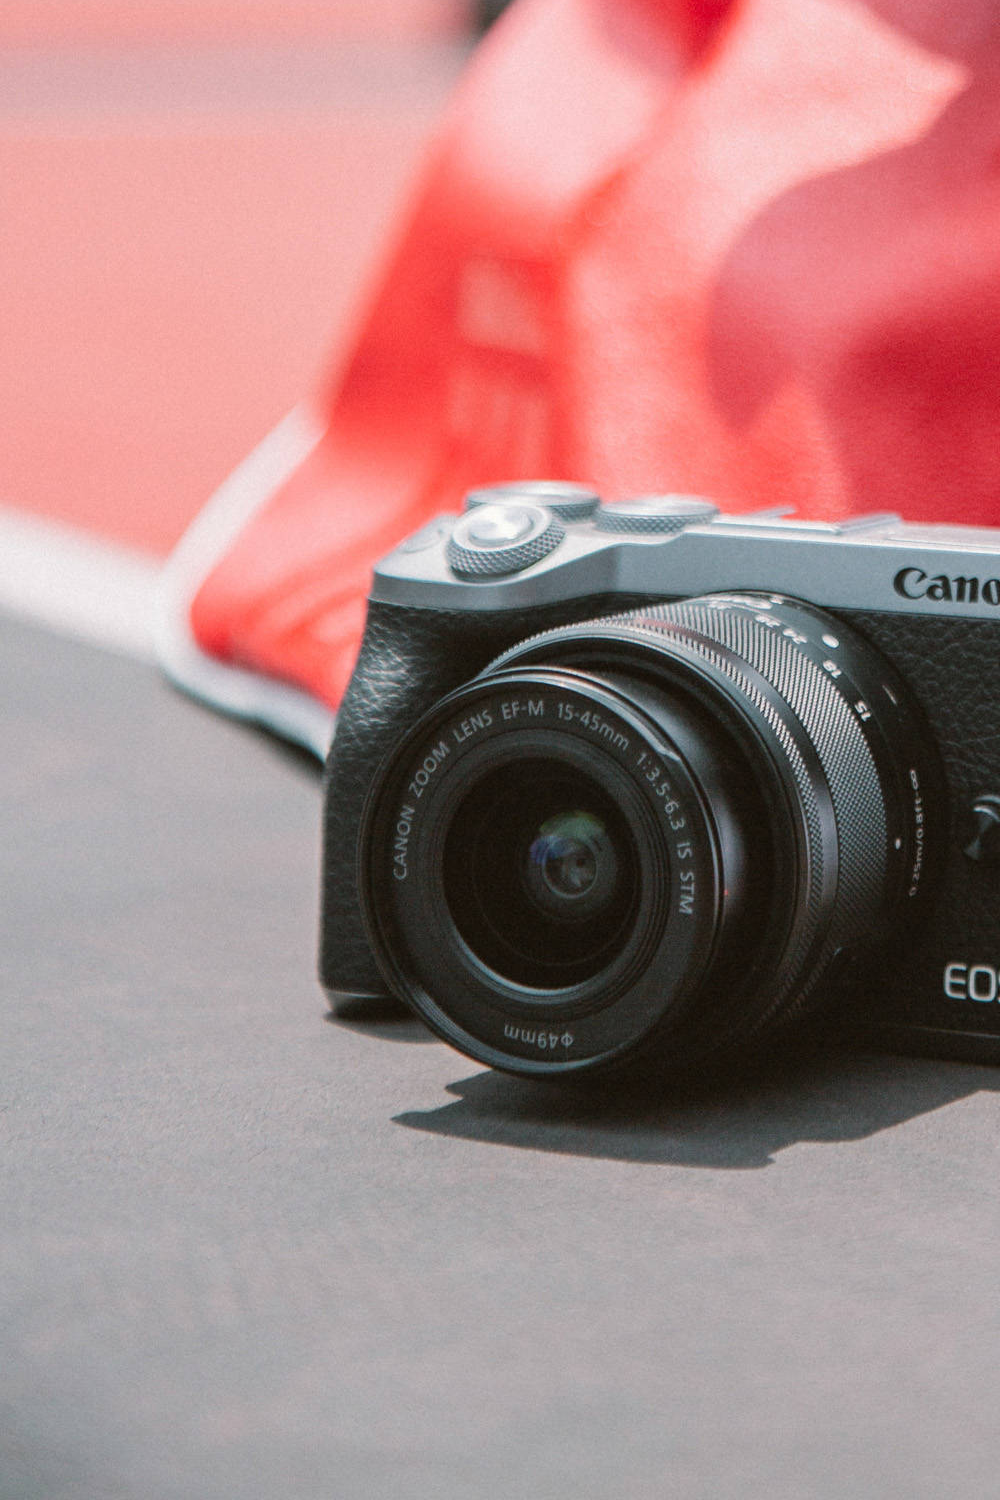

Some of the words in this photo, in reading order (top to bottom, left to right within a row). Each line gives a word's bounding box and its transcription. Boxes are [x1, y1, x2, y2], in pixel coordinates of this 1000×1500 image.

[452, 709, 493, 743] LENS
[501, 699, 545, 720] EF-M
[557, 702, 630, 750] 15-45mm
[409, 740, 450, 798] ZOOM
[635, 752, 686, 831] 1:3.5-6.3
[393, 805, 415, 880] CANON
[676, 841, 692, 860] IS
[679, 871, 695, 915] STM
